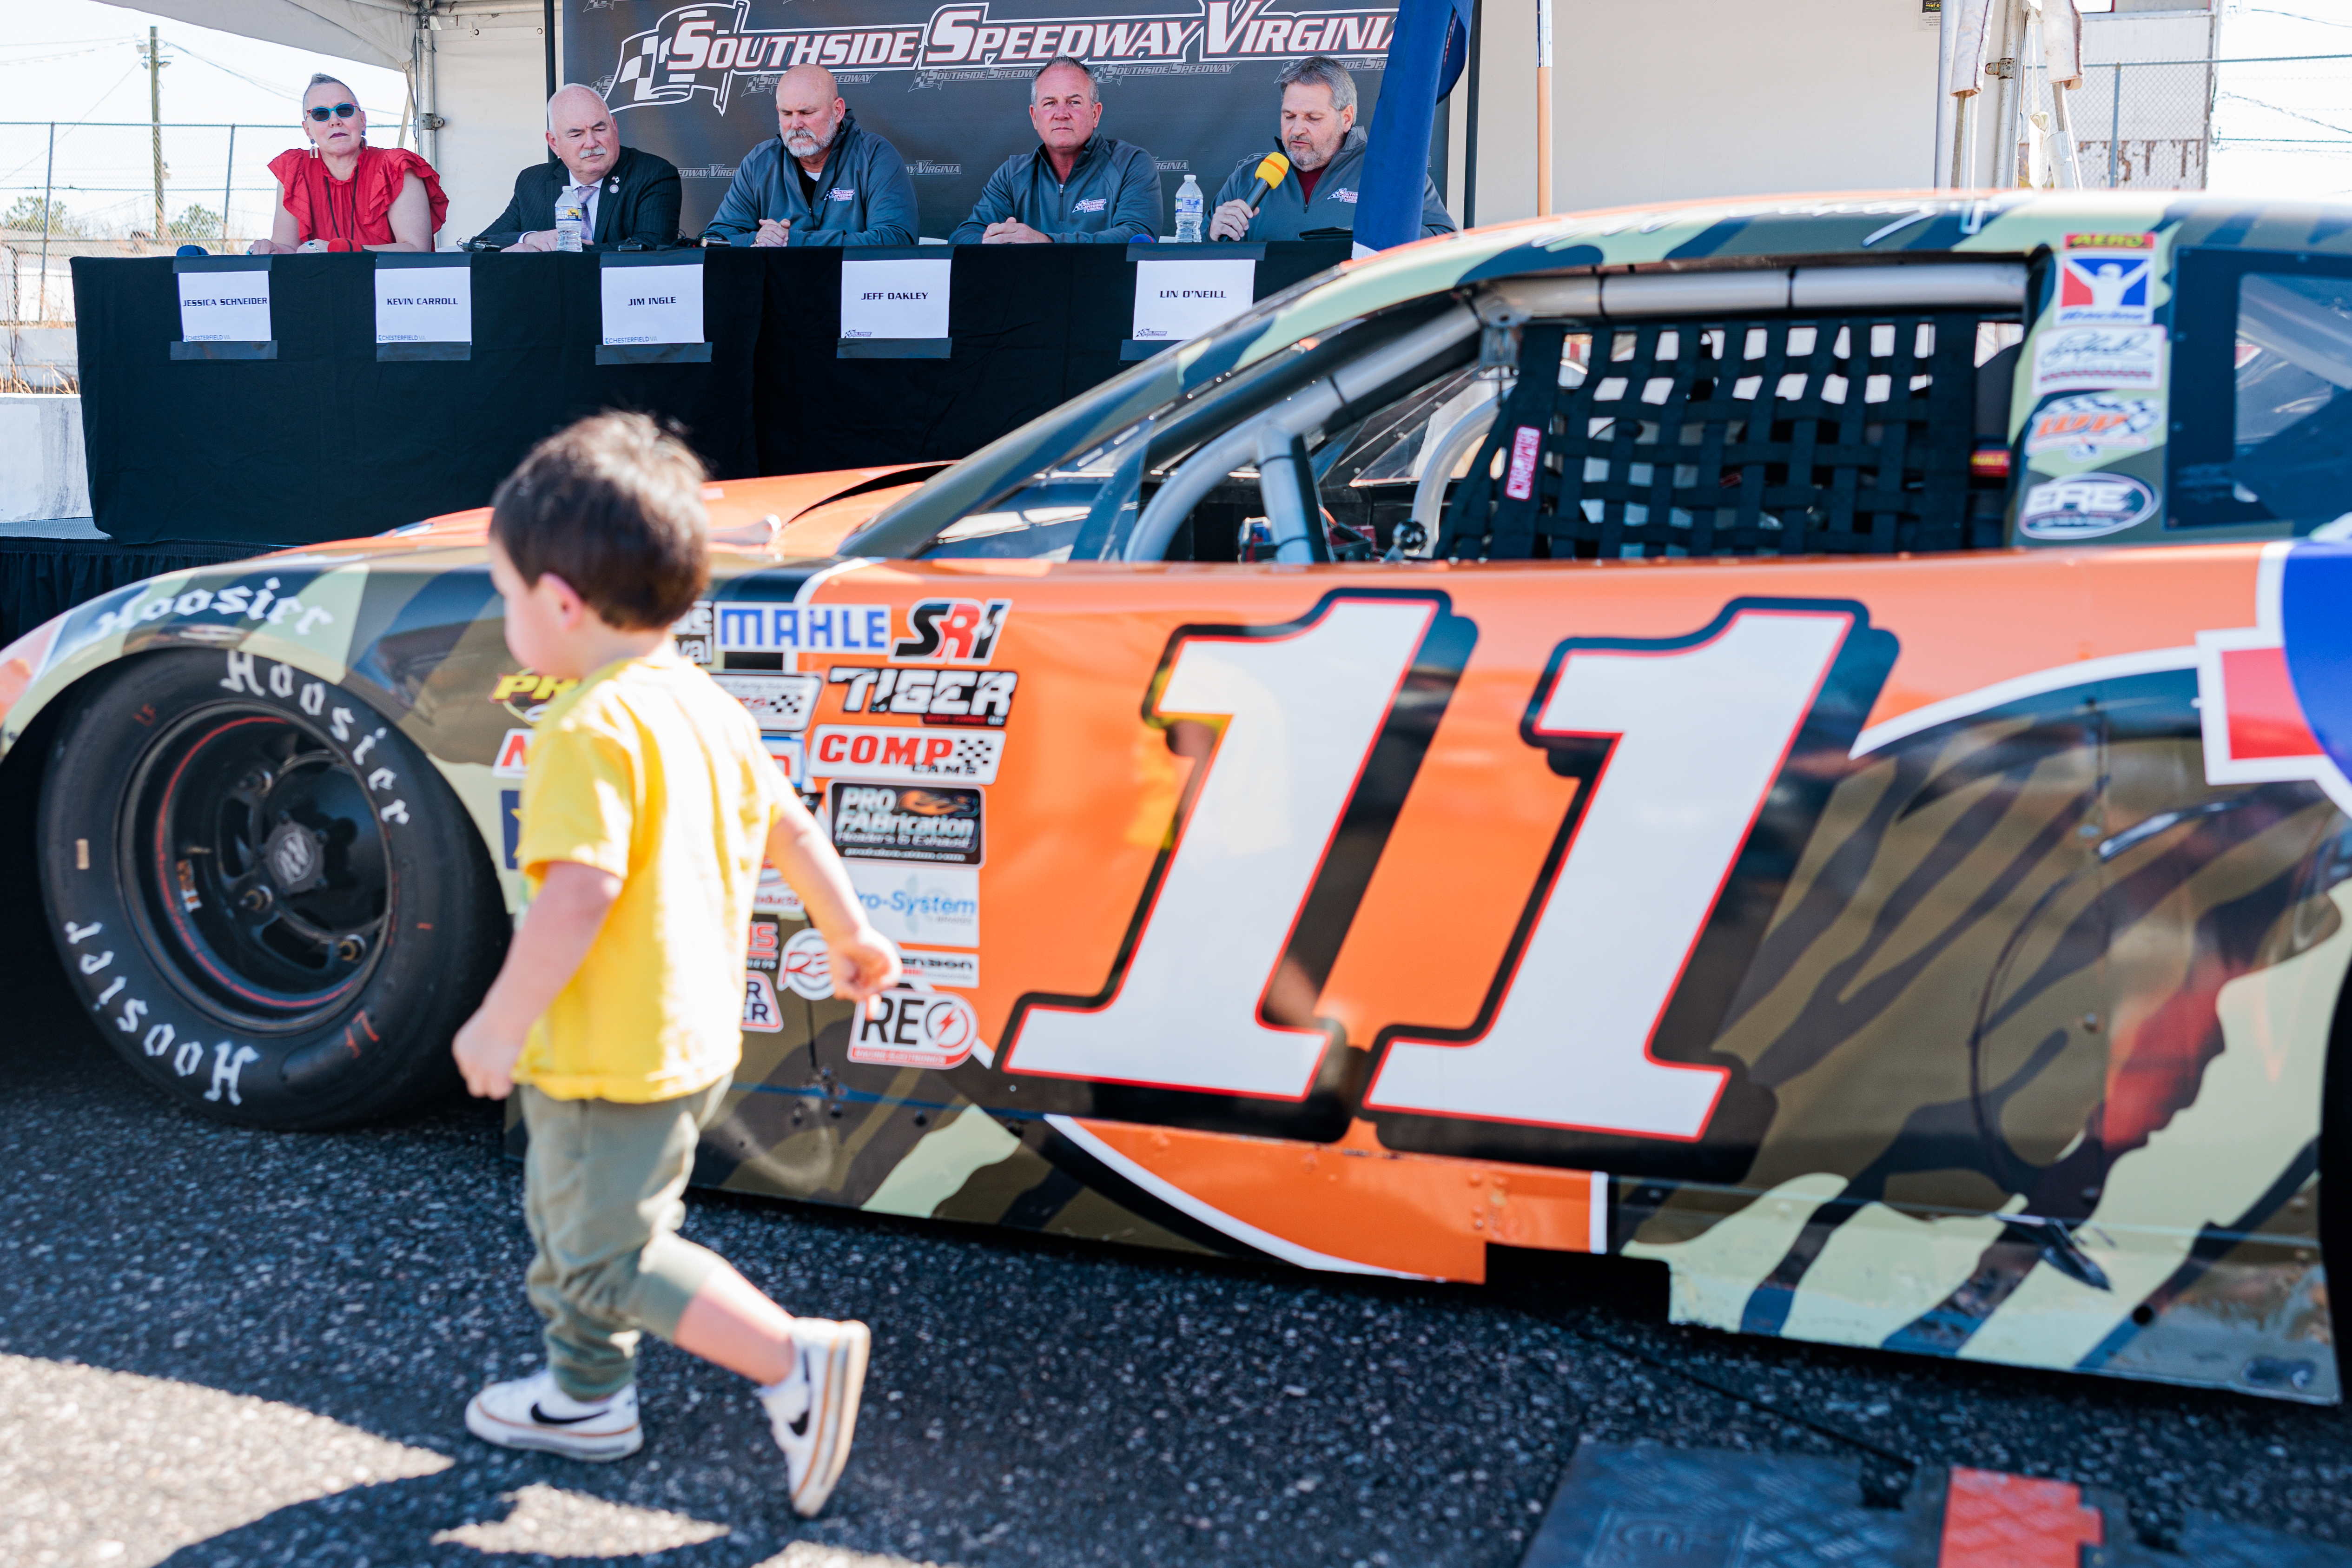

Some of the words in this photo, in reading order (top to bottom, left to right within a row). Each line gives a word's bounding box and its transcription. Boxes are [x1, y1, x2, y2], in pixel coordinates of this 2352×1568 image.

[667, 20, 925, 70] SOUTHSIDE
[926, 10, 1202, 63] SPEEDWAY
[834, 73, 872, 83] EEDWAY
[927, 68, 986, 80] SOUTHSIDE
[1105, 64, 1169, 75] SOUTHSIDE
[1170, 62, 1234, 74] SPEEDWAY
[679, 169, 709, 177] EDWAY
[709, 165, 738, 177] VIRGI
[917, 161, 959, 173] VIRGINIA
[1156, 162, 1187, 170] RGINIA
[183, 298, 217, 307] JESSICA
[220, 297, 268, 306] SCHNEIDER
[628, 297, 645, 306] JIM
[648, 296, 677, 306] INGLE
[888, 291, 929, 300] OAKLEY
[2025, 483, 2135, 515] ERE
[89, 577, 334, 636] Hoosier
[720, 609, 886, 649] MAHLE
[892, 600, 1009, 661] SRI
[829, 667, 1018, 716] TIGER
[219, 649, 410, 825] Hoosier
[819, 734, 953, 767] COMP
[840, 787, 897, 813] PRO
[835, 810, 975, 838] FABrication
[999, 596, 1857, 1145] 11
[859, 890, 976, 917] ro-System
[64, 920, 260, 1106] Hoosier
